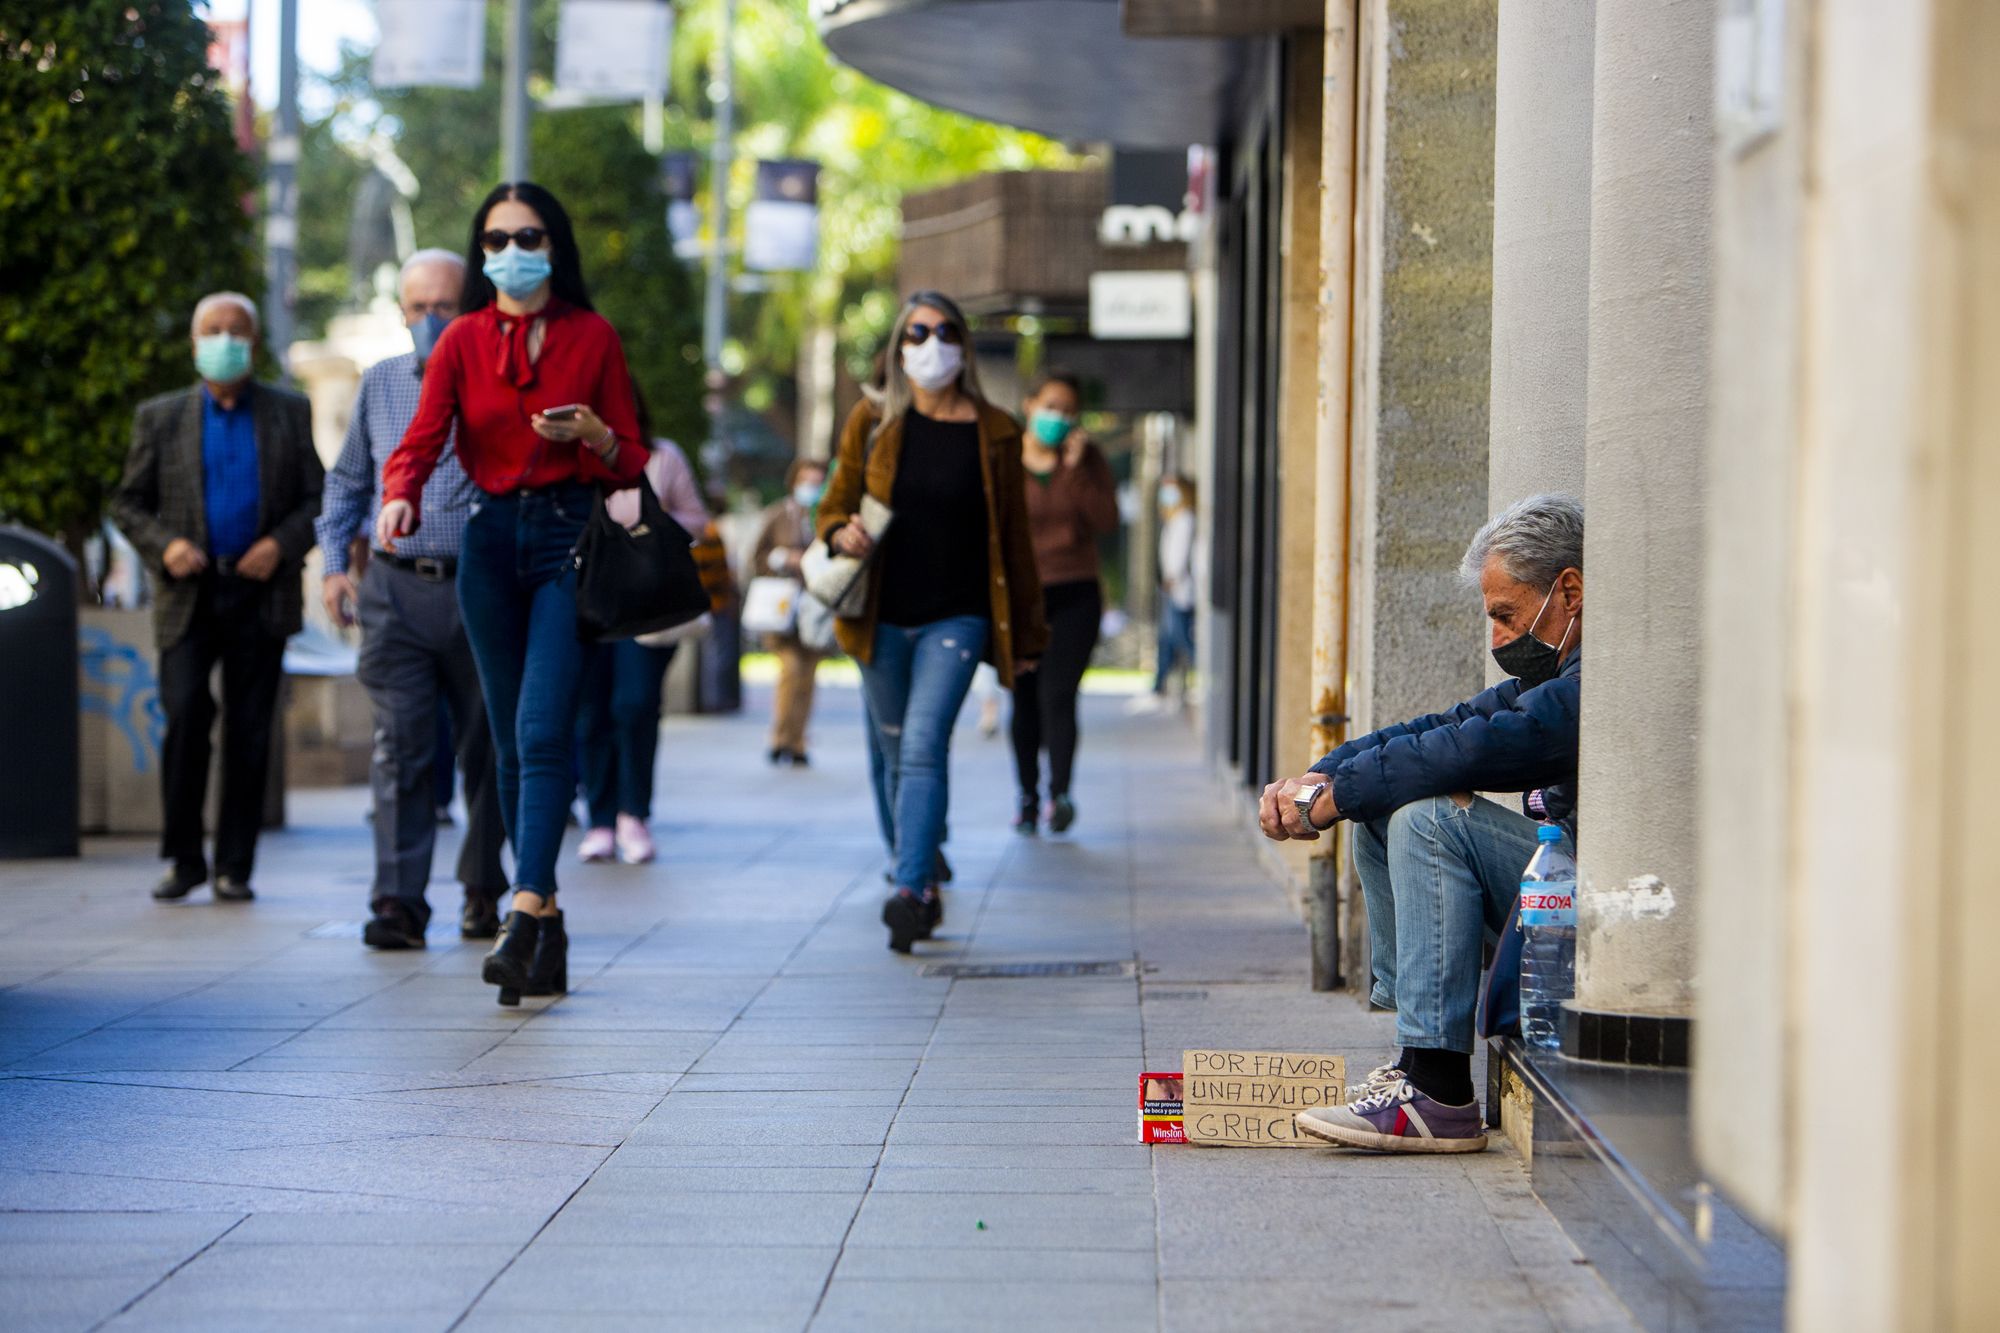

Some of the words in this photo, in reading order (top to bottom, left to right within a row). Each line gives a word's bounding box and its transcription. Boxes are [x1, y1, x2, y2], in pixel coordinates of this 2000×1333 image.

[1520, 895, 1572, 910] BEZOYA
[1193, 1053, 1245, 1073] POR
[1253, 1055, 1336, 1079] FAVOR
[1192, 1080, 1242, 1101] UNA
[1251, 1083, 1338, 1106] AYUDA
[1152, 1126, 1183, 1138] Winston
